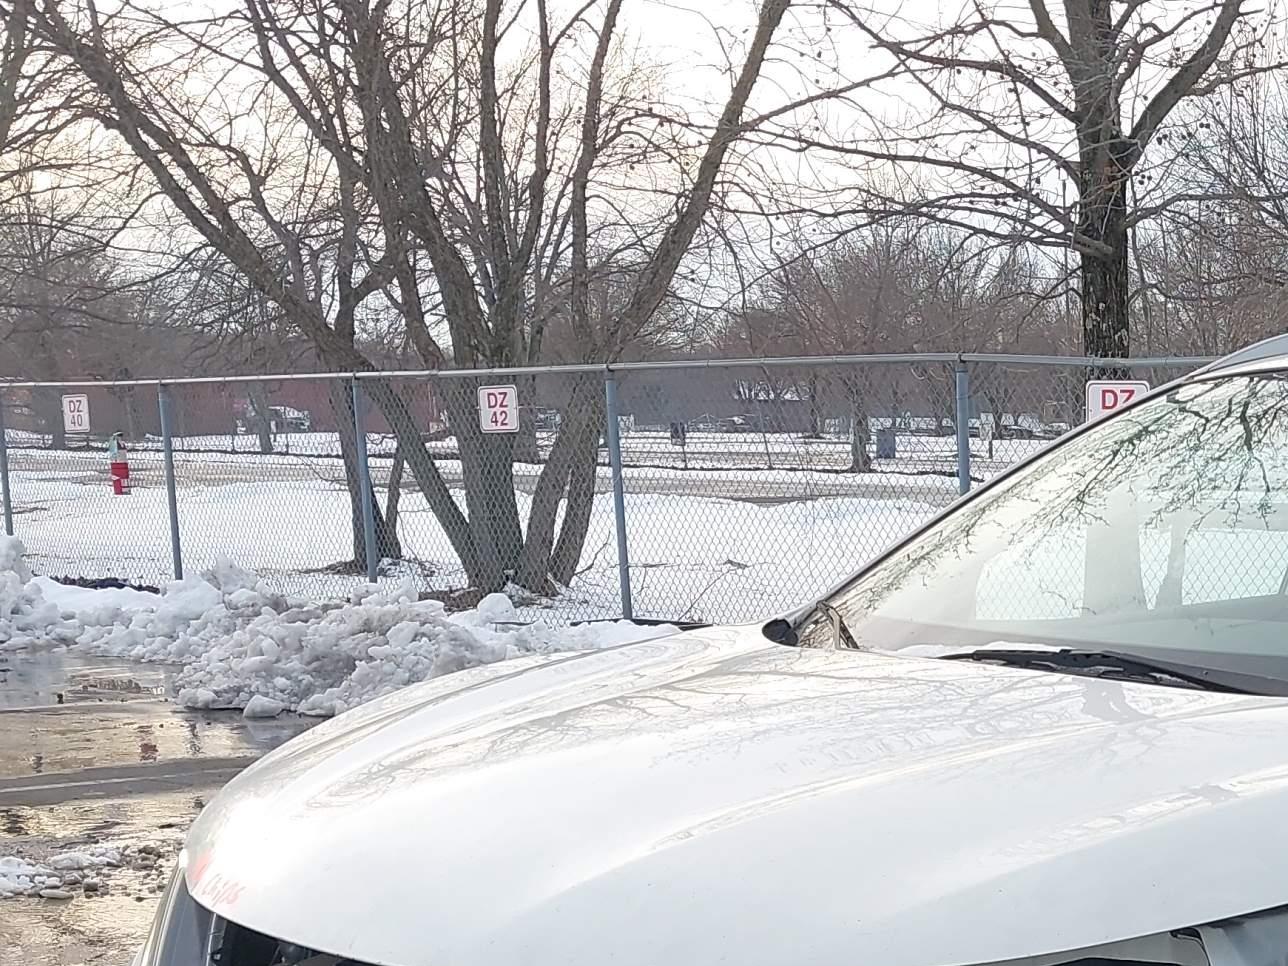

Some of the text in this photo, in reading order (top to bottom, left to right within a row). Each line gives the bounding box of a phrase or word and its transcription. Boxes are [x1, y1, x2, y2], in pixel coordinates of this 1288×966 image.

[69, 400, 83, 413] DZ
[487, 392, 508, 408] DZ
[71, 415, 82, 426] 40
[490, 410, 508, 426] 42
